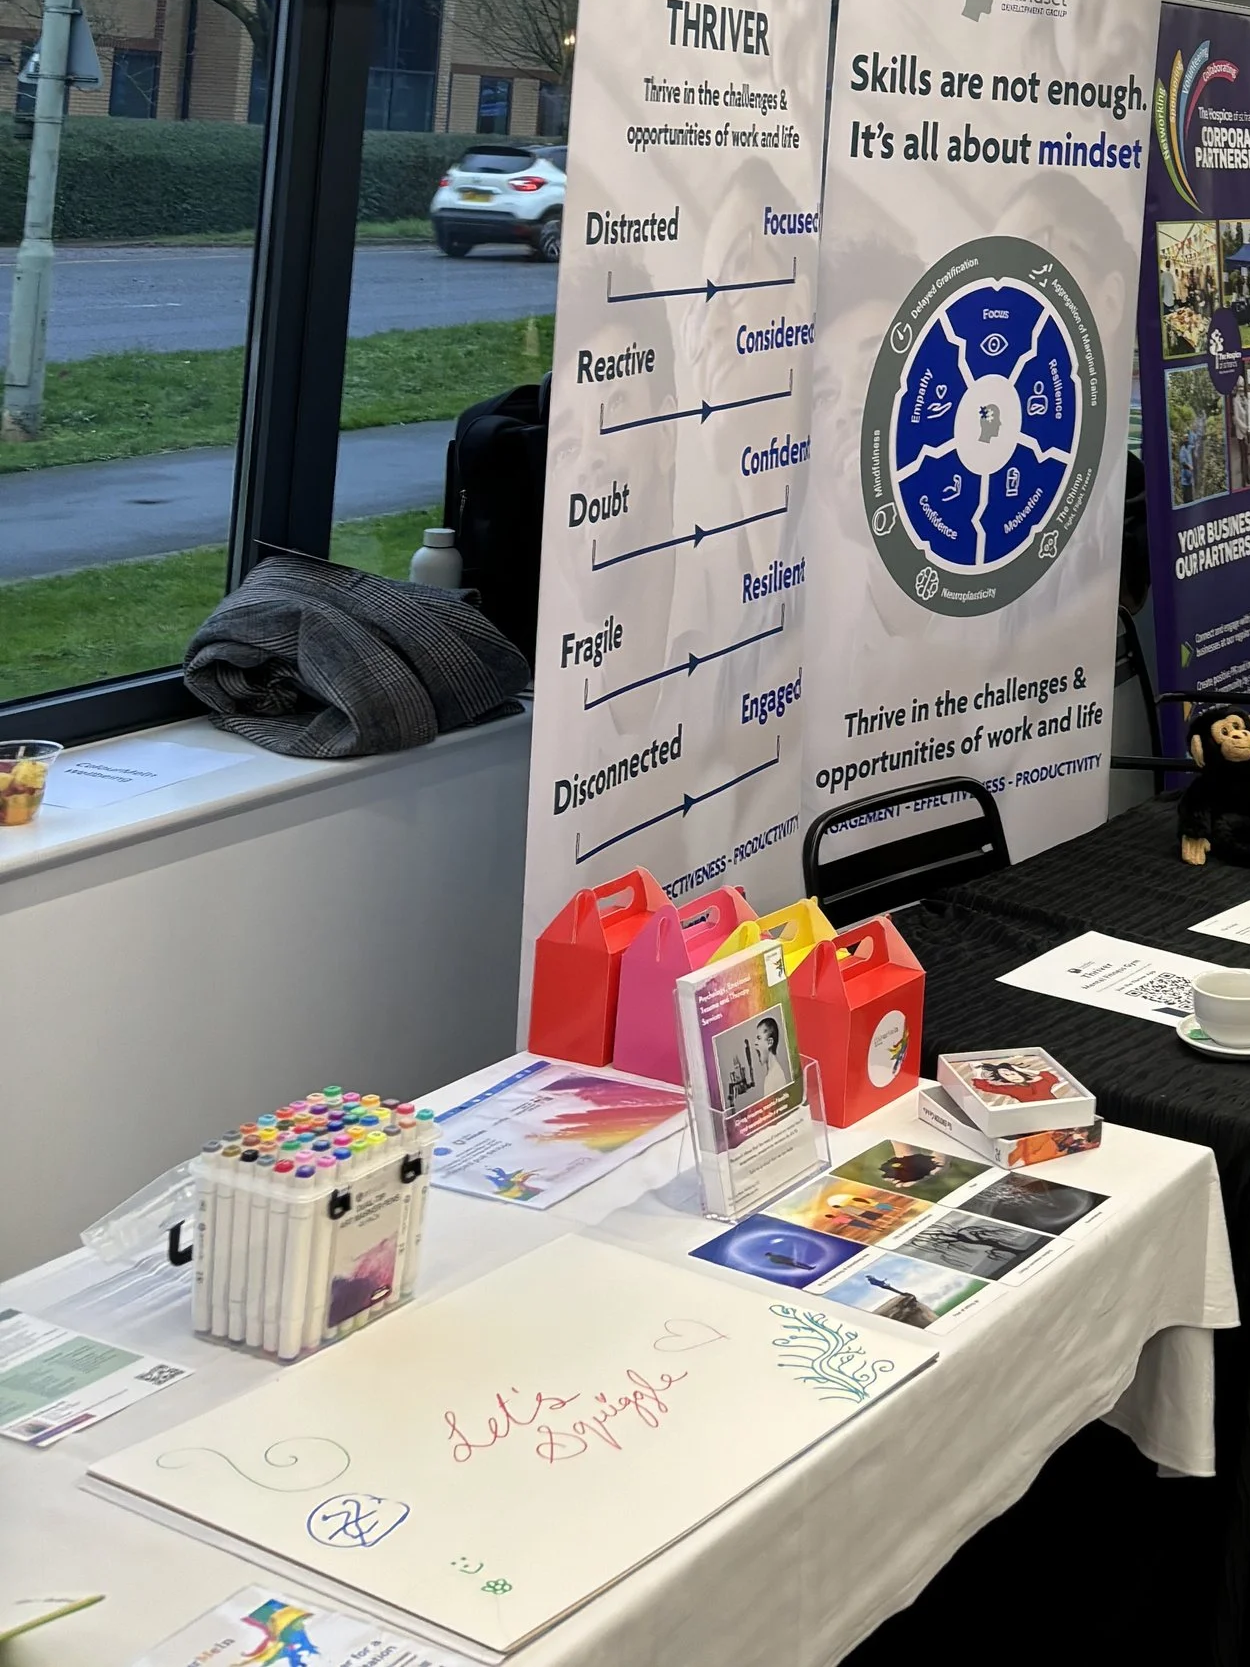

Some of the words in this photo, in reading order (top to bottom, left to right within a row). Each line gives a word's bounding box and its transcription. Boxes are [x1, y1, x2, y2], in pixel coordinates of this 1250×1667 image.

[1001, 3, 1044, 16] DEVELOPMENT
[1045, 8, 1068, 18] GROUP
[644, 76, 680, 104] Thrive
[684, 81, 694, 104] in
[699, 81, 719, 106] the
[723, 82, 778, 115] challenges
[780, 89, 788, 111] &
[850, 52, 932, 96] Skills
[940, 70, 984, 100] are
[992, 72, 1040, 104] not
[1048, 74, 1147, 120] enough.
[627, 122, 711, 152] opportunities
[715, 122, 730, 146] of
[732, 125, 758, 148] work
[761, 125, 780, 148] and
[782, 125, 800, 149] life
[1158, 86, 1170, 160] Networking
[1198, 106, 1208, 120] The
[1208, 108, 1232, 124] Hospice
[904, 120, 938, 162] all
[947, 124, 1032, 164] about
[1038, 131, 1142, 170] mindset
[586, 206, 680, 245] Distracted
[910, 284, 938, 319] Delayed
[935, 257, 979, 290] Gratification
[982, 308, 1010, 320] Focus
[577, 342, 655, 384] Reactive
[1052, 278, 1082, 324] Aggregation
[1078, 324, 1086, 332] of
[1082, 332, 1097, 376] Marginal
[1090, 378, 1098, 406] Gains
[910, 368, 934, 424] Empathy
[1048, 359, 1062, 420] Resilience
[568, 481, 630, 528] Doubt
[742, 434, 811, 477] Confident
[872, 430, 881, 498] Mindfulness
[919, 495, 958, 540] Confidence
[1004, 488, 1044, 534] Motivation
[1056, 506, 1070, 523] The
[1066, 474, 1082, 504] Chimp
[1178, 526, 1205, 553] YOUR
[1175, 556, 1200, 580] OUR
[560, 615, 623, 668] Fragile
[742, 557, 806, 604] Resilient
[940, 587, 996, 603] Neuroplasticity
[844, 706, 906, 738] Thrive
[912, 699, 929, 724] in
[935, 690, 968, 718] the
[974, 673, 1068, 710] challenges
[1072, 666, 1086, 690] &
[553, 722, 682, 816] Disconnected
[741, 667, 802, 725] Engaged
[816, 738, 955, 794] opportunities
[960, 726, 984, 755] of
[987, 716, 1032, 748] work
[1038, 706, 1072, 737] and
[1076, 702, 1103, 730] life
[1016, 753, 1102, 788] PRODUCTIVITY
[734, 815, 799, 865] PRODUCTIVITY
[1080, 964, 1112, 978] Thriver
[1081, 978, 1105, 990] Mental
[1104, 966, 1124, 980] Fitness
[1124, 960, 1140, 970] Gym
[699, 987, 726, 1003] Psychology,
[700, 1002, 719, 1014] Trauma
[720, 997, 730, 1006] and
[729, 988, 750, 1002] Therapy
[702, 1012, 722, 1026] Services
[445, 1387, 580, 1462] Let's
[536, 1368, 688, 1463] Squiggle
[351, 1646, 370, 1659] for
